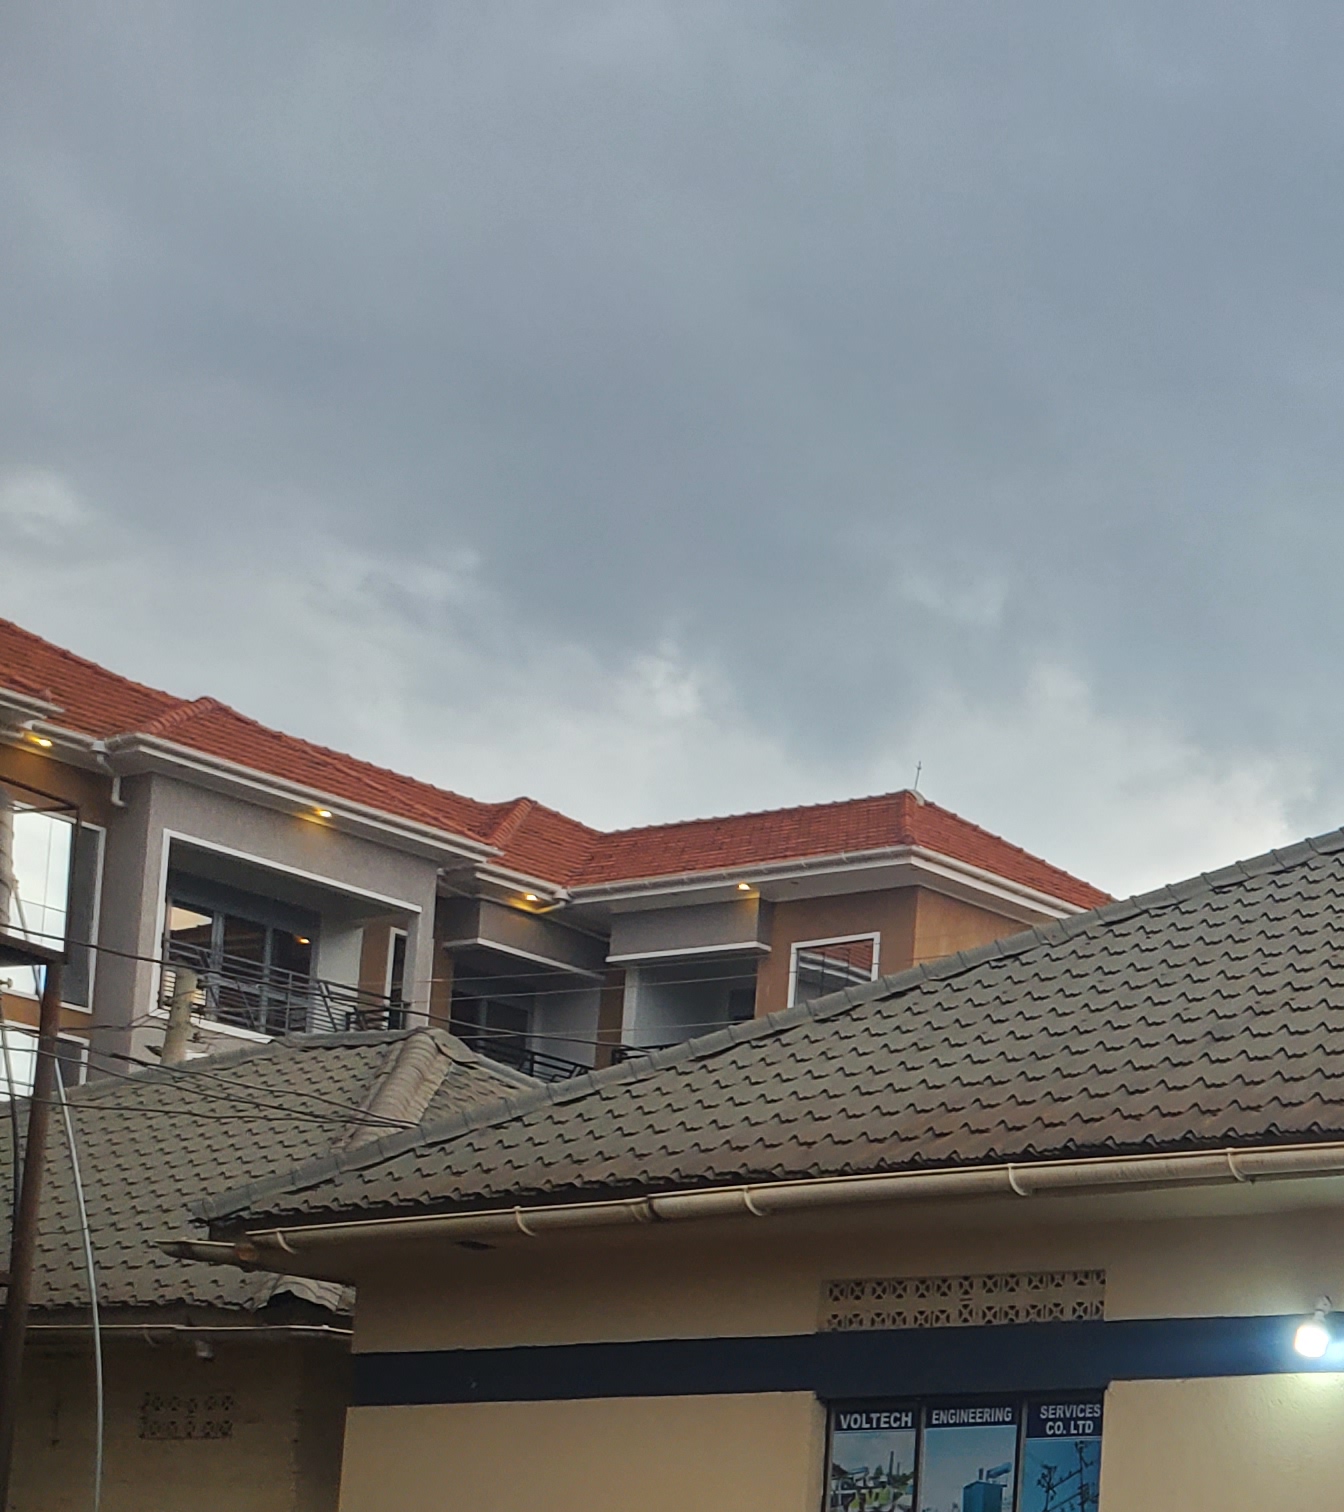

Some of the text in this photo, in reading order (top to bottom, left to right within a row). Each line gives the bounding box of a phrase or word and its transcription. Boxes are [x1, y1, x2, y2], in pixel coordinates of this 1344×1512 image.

[840, 1404, 1101, 1429] VOLTECH ENGINEERING SERVICES
[1046, 1421, 1093, 1435] CO. LTD
